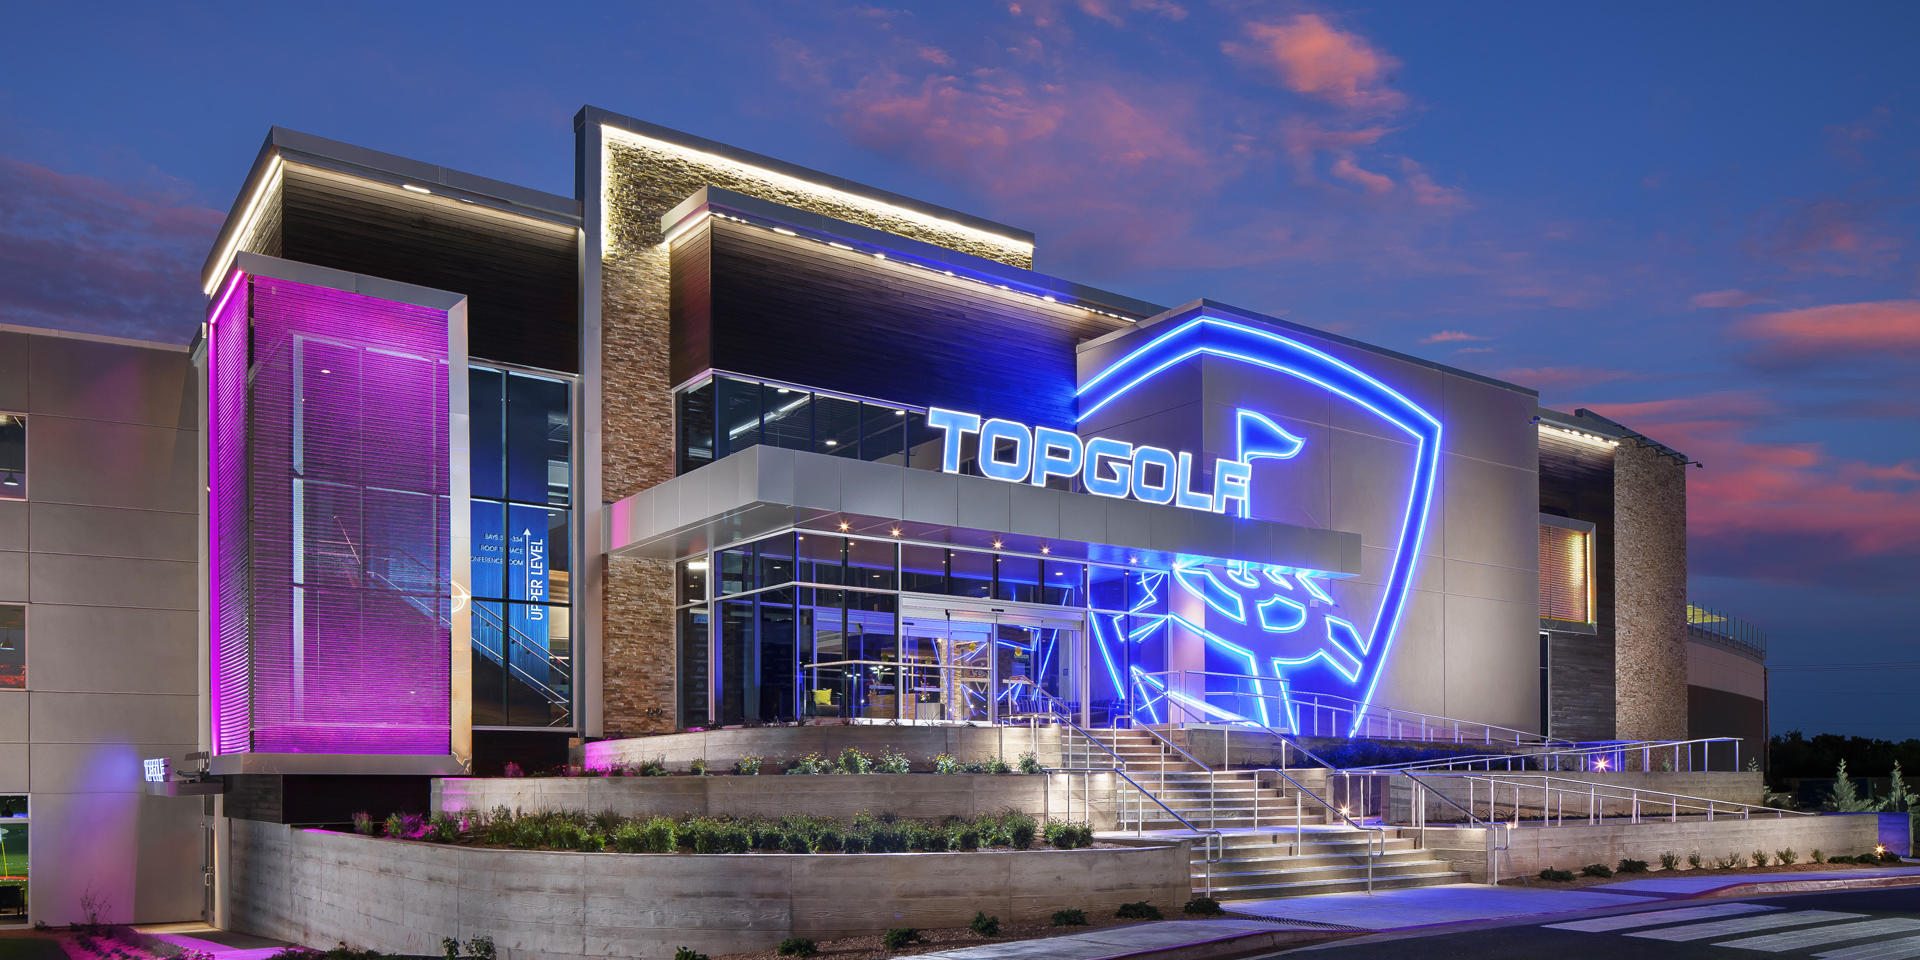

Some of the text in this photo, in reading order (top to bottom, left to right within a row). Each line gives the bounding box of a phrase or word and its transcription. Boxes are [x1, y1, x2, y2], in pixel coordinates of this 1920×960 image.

[927, 406, 1252, 514] TOPGOLF
[471, 556, 503, 564] ONFERENCE
[530, 539, 543, 620] UPPER LEVEL
